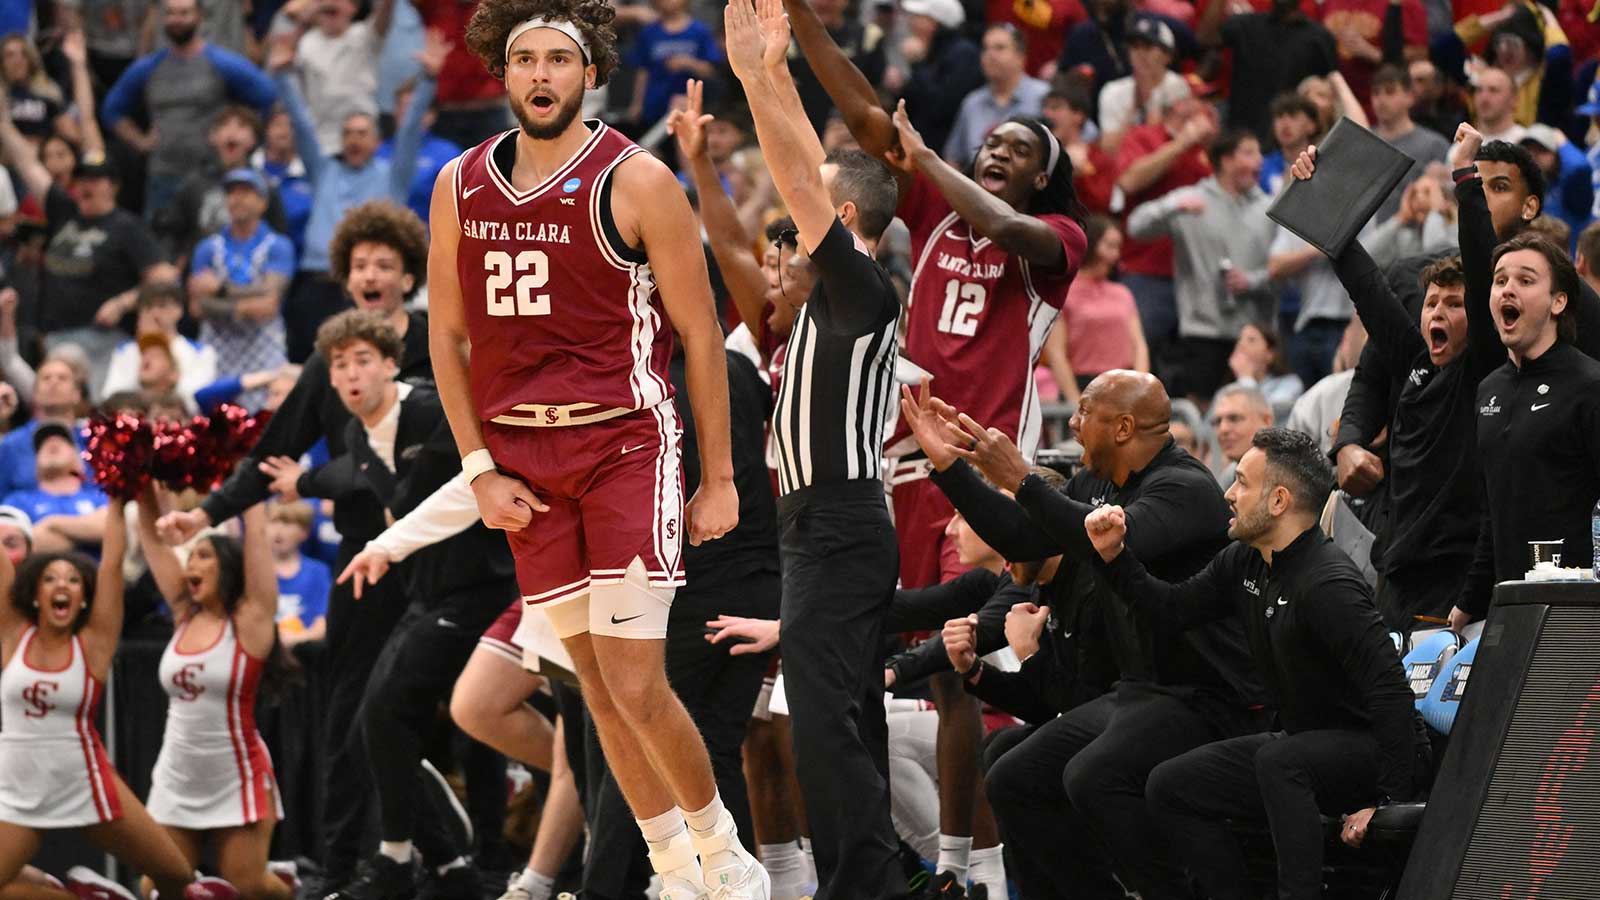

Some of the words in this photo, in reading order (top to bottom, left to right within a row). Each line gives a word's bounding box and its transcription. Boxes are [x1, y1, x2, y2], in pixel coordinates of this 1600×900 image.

[463, 218, 511, 241] SANTA
[515, 222, 571, 244] CLARA
[484, 250, 551, 316] 22
[937, 279, 986, 337] 12
